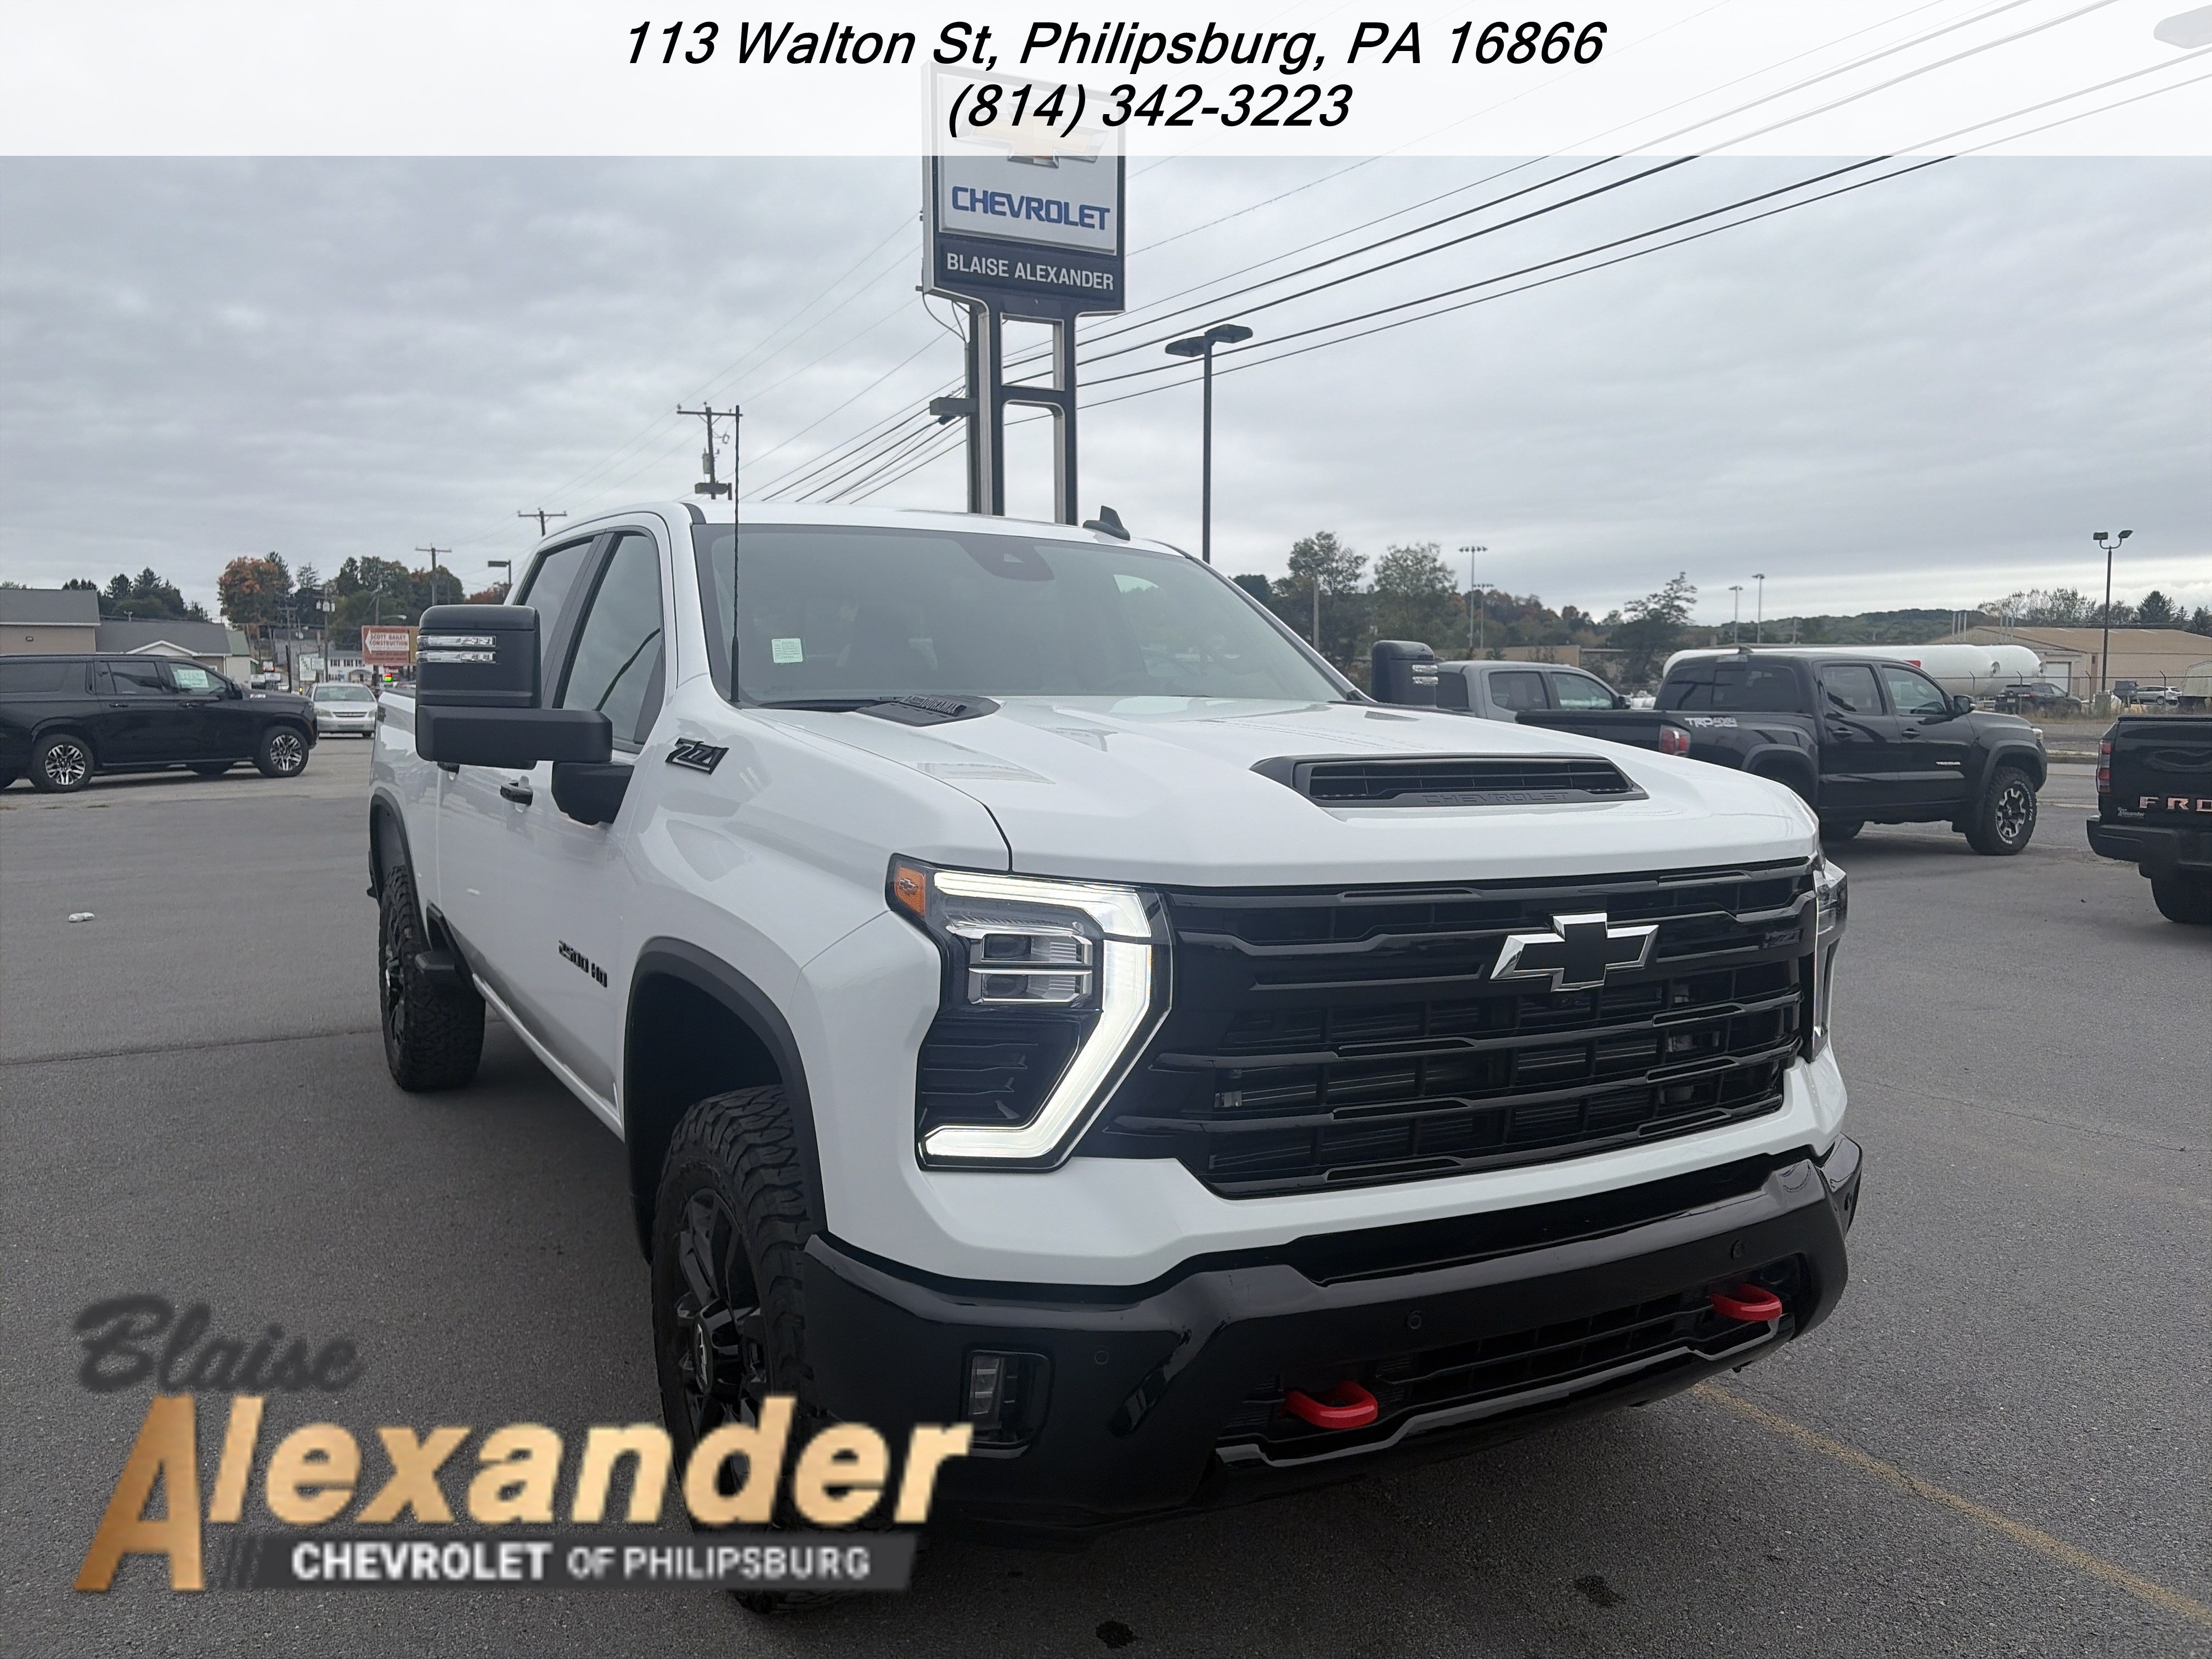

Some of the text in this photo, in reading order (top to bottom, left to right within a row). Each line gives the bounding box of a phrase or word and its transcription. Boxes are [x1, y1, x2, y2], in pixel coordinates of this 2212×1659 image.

[951, 186, 1111, 230] CHEVROLET
[946, 252, 1114, 291] BLAISE ALEXANDER
[1421, 792, 1568, 804] CHEVROLET
[558, 939, 607, 988] 2500 HD
